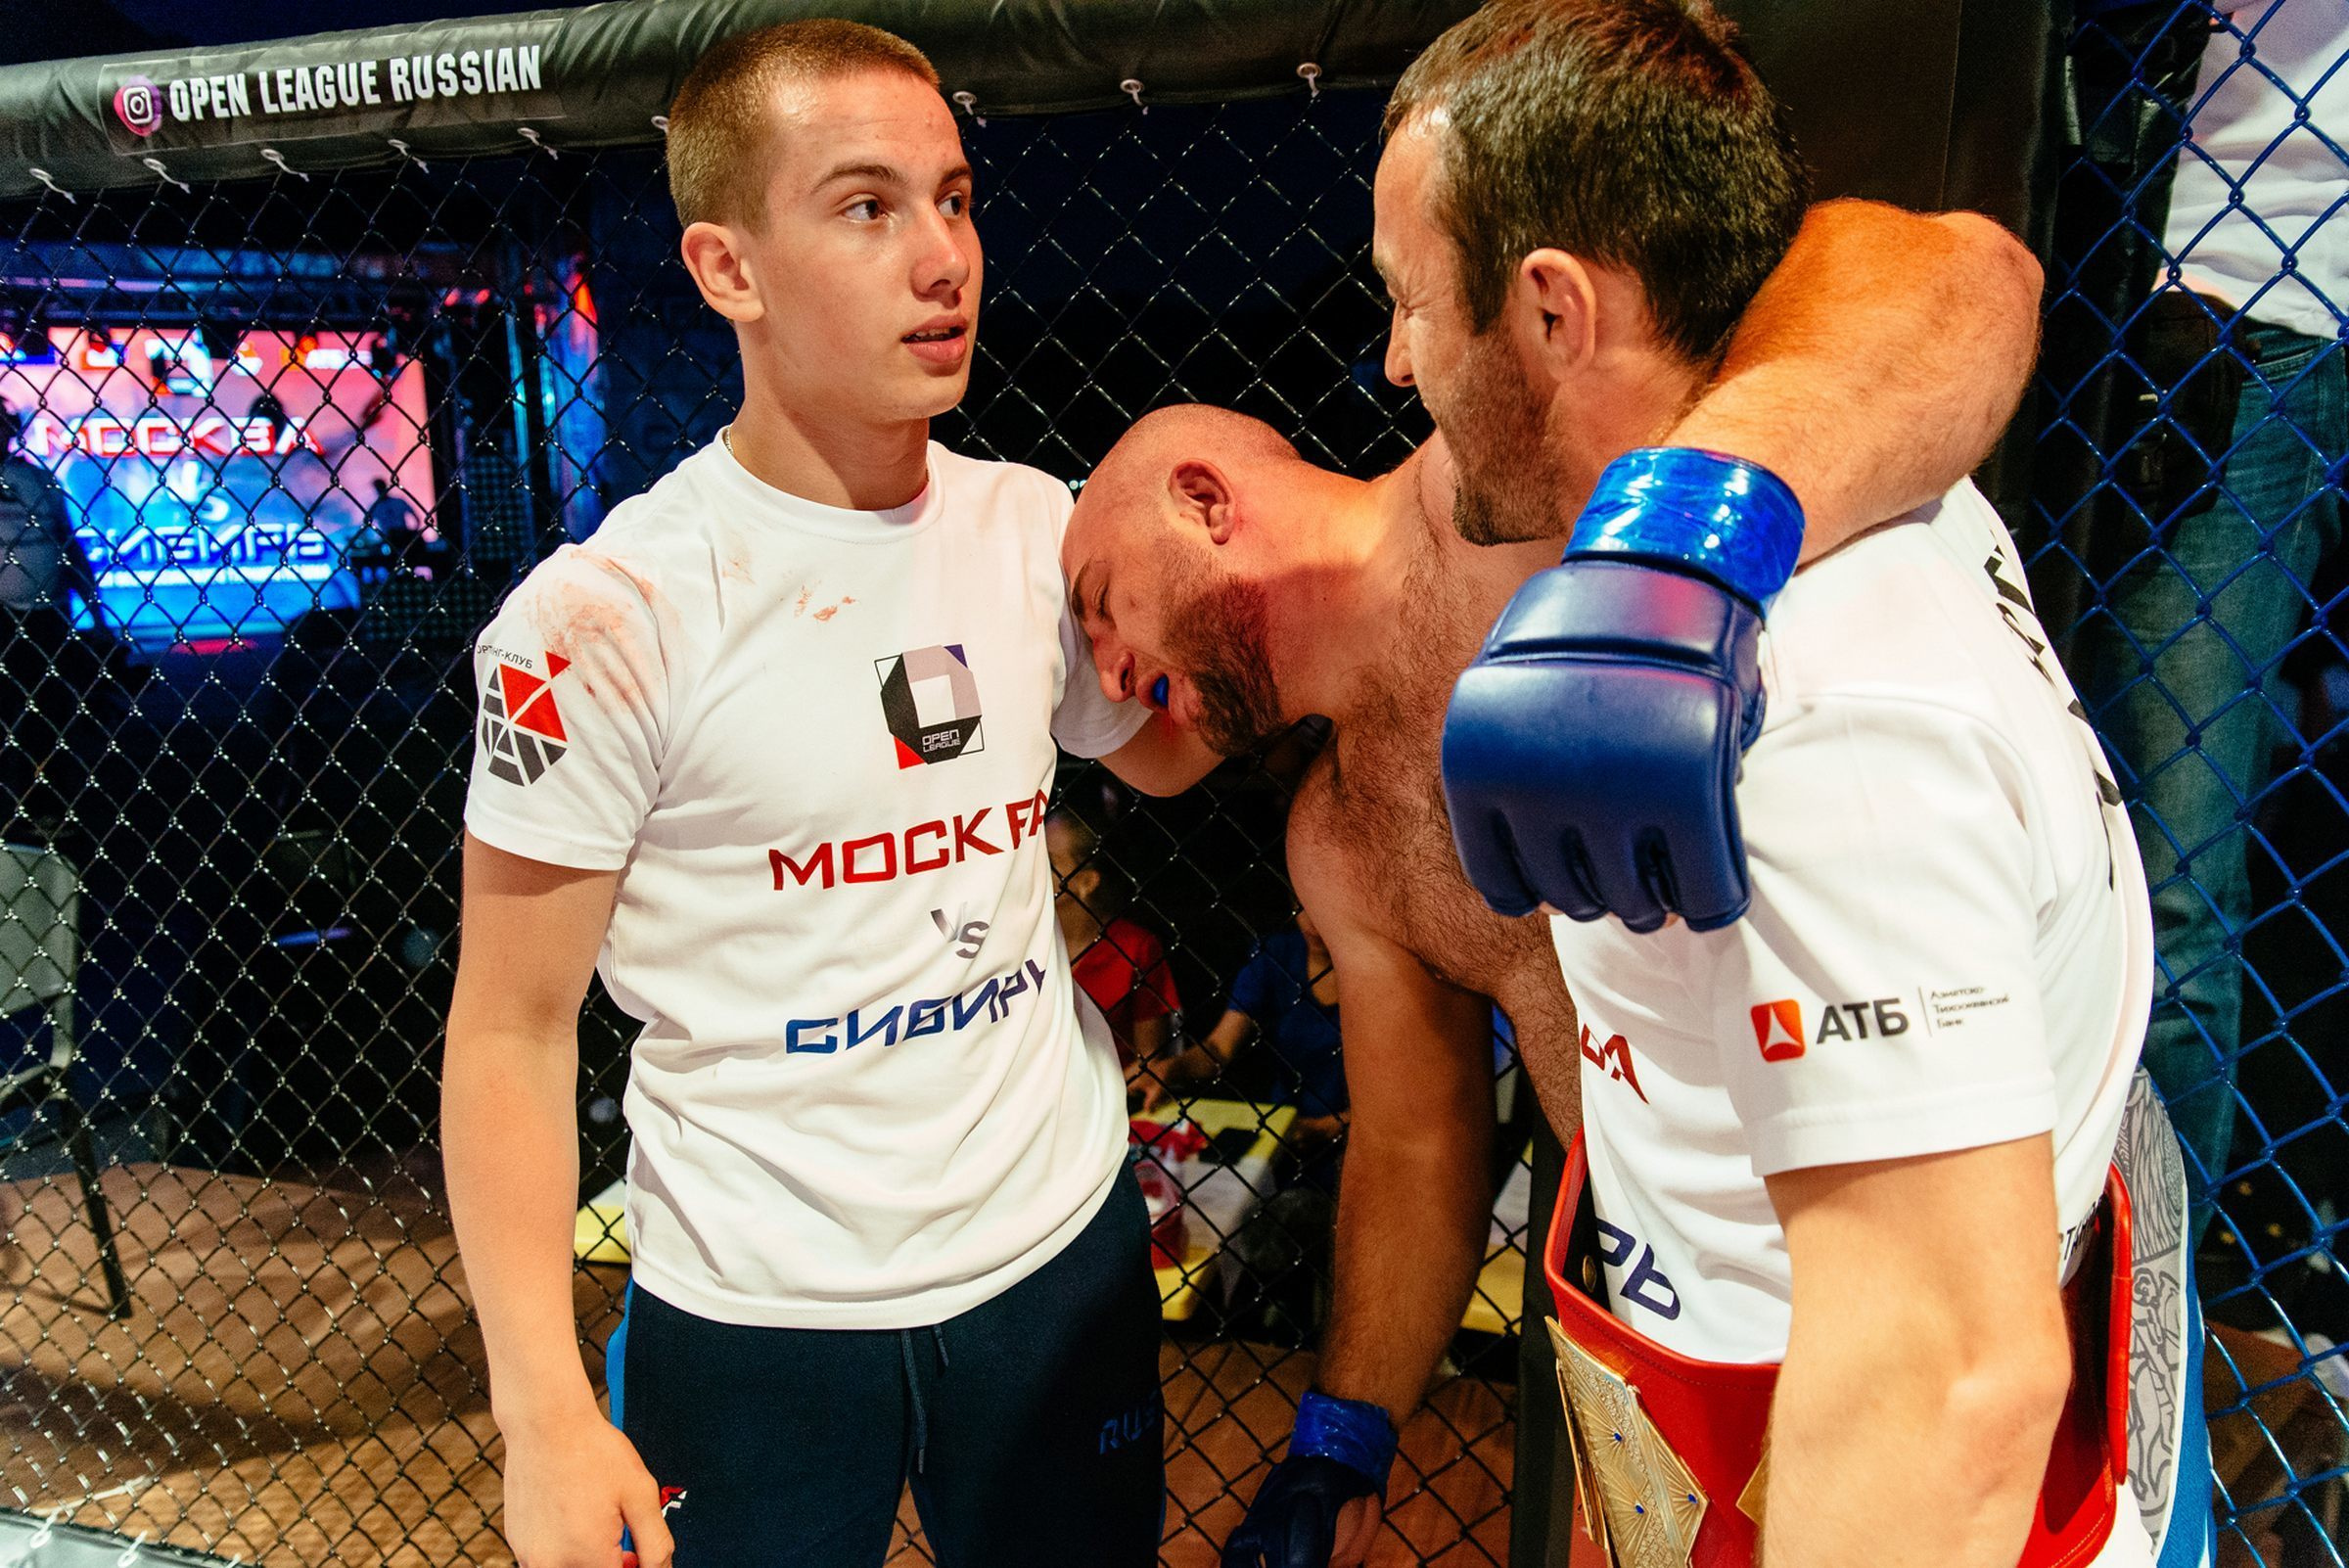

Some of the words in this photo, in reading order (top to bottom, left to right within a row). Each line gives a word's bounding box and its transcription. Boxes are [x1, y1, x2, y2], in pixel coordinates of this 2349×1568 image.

[169, 72, 251, 121] OPEN
[259, 62, 381, 114] LEAGUE
[391, 45, 541, 103] RUSSIAN
[32, 416, 325, 456] МОСКВА
[922, 729, 959, 746] OPEN
[923, 738, 960, 753] LEAGUE
[931, 901, 990, 959] VS
[1817, 997, 1910, 1044] АТБ
